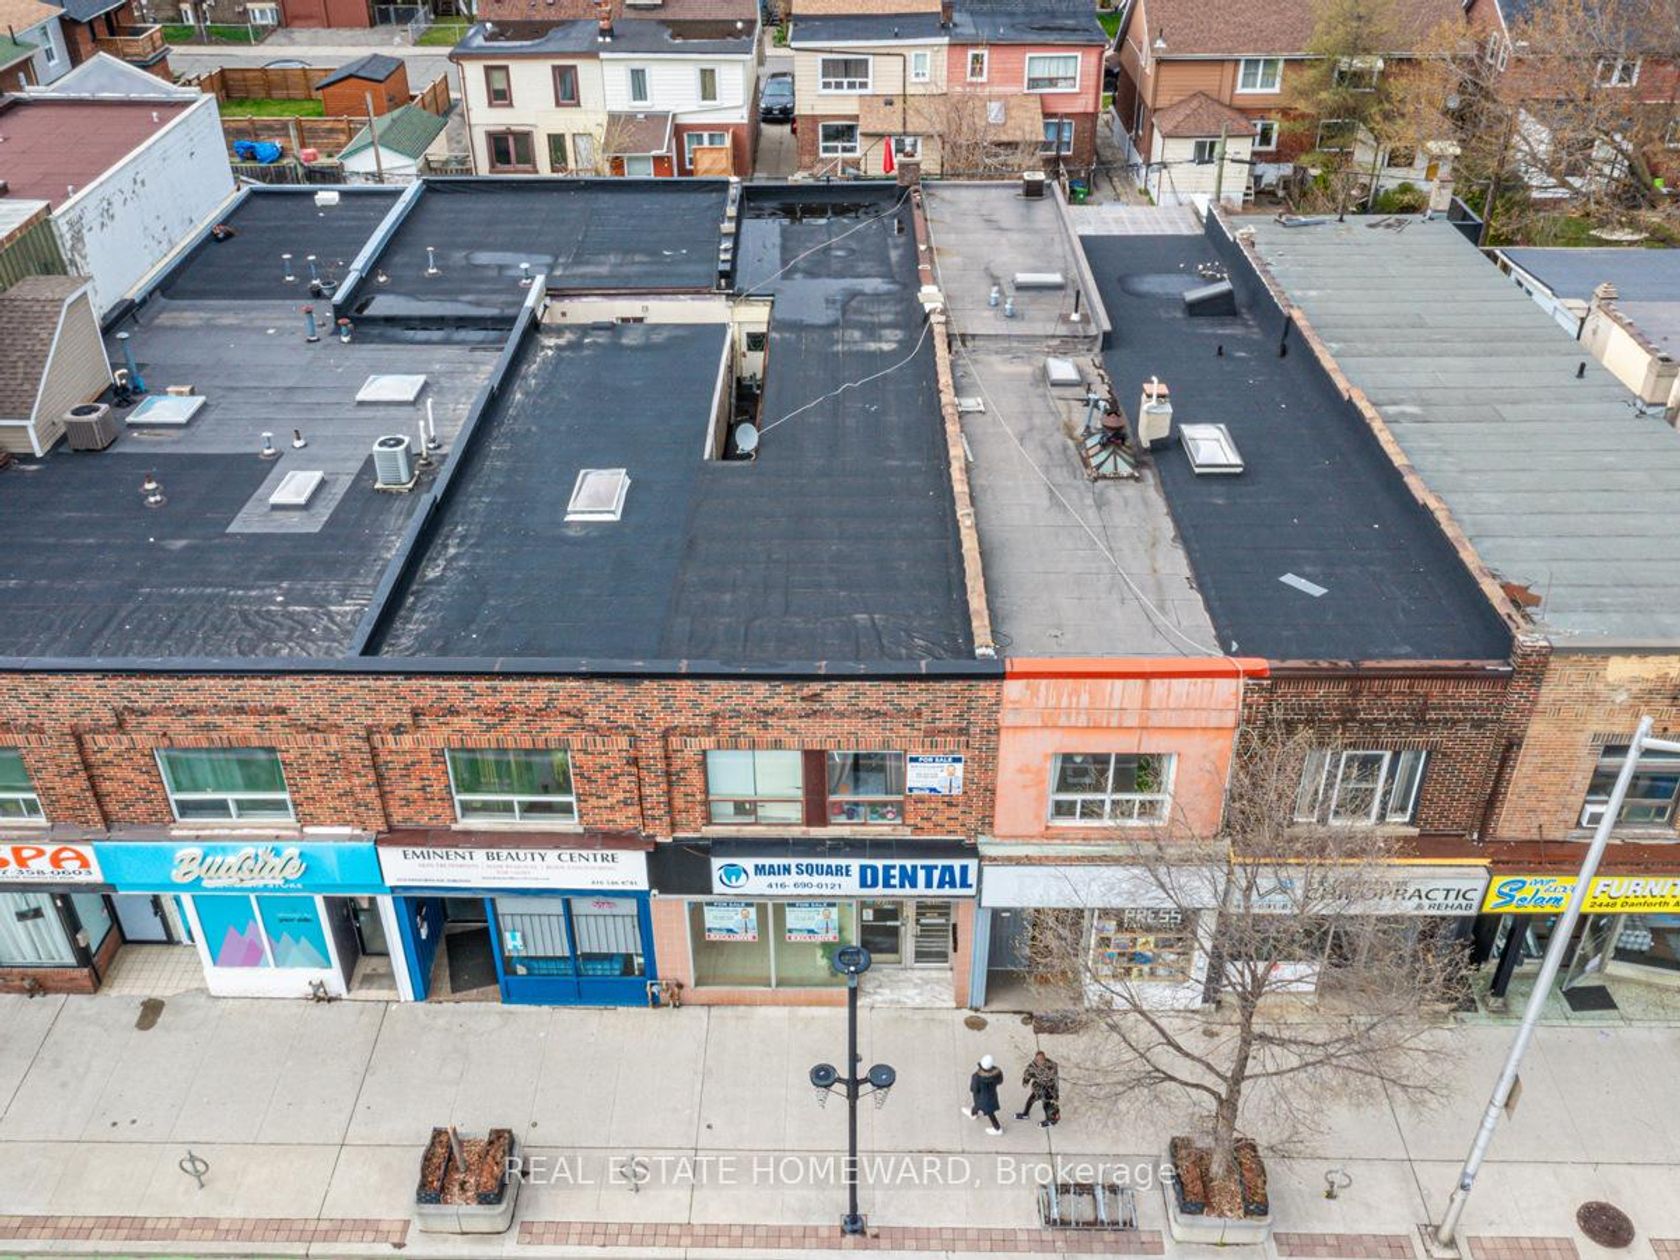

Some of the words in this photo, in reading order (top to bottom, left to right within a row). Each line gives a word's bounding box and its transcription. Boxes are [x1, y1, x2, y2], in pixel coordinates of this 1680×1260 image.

[402, 849, 475, 861] EMINENT
[485, 850, 547, 862] BEAUTY
[556, 852, 620, 864] CENTRE
[753, 862, 792, 877] MAIN
[795, 862, 853, 878] SQUARE
[858, 863, 974, 890] DENTAL
[1427, 903, 1474, 912] REHAB
[1589, 900, 1617, 909] 2448
[1620, 900, 1671, 909] Danforth
[1124, 908, 1183, 924] PRESS
